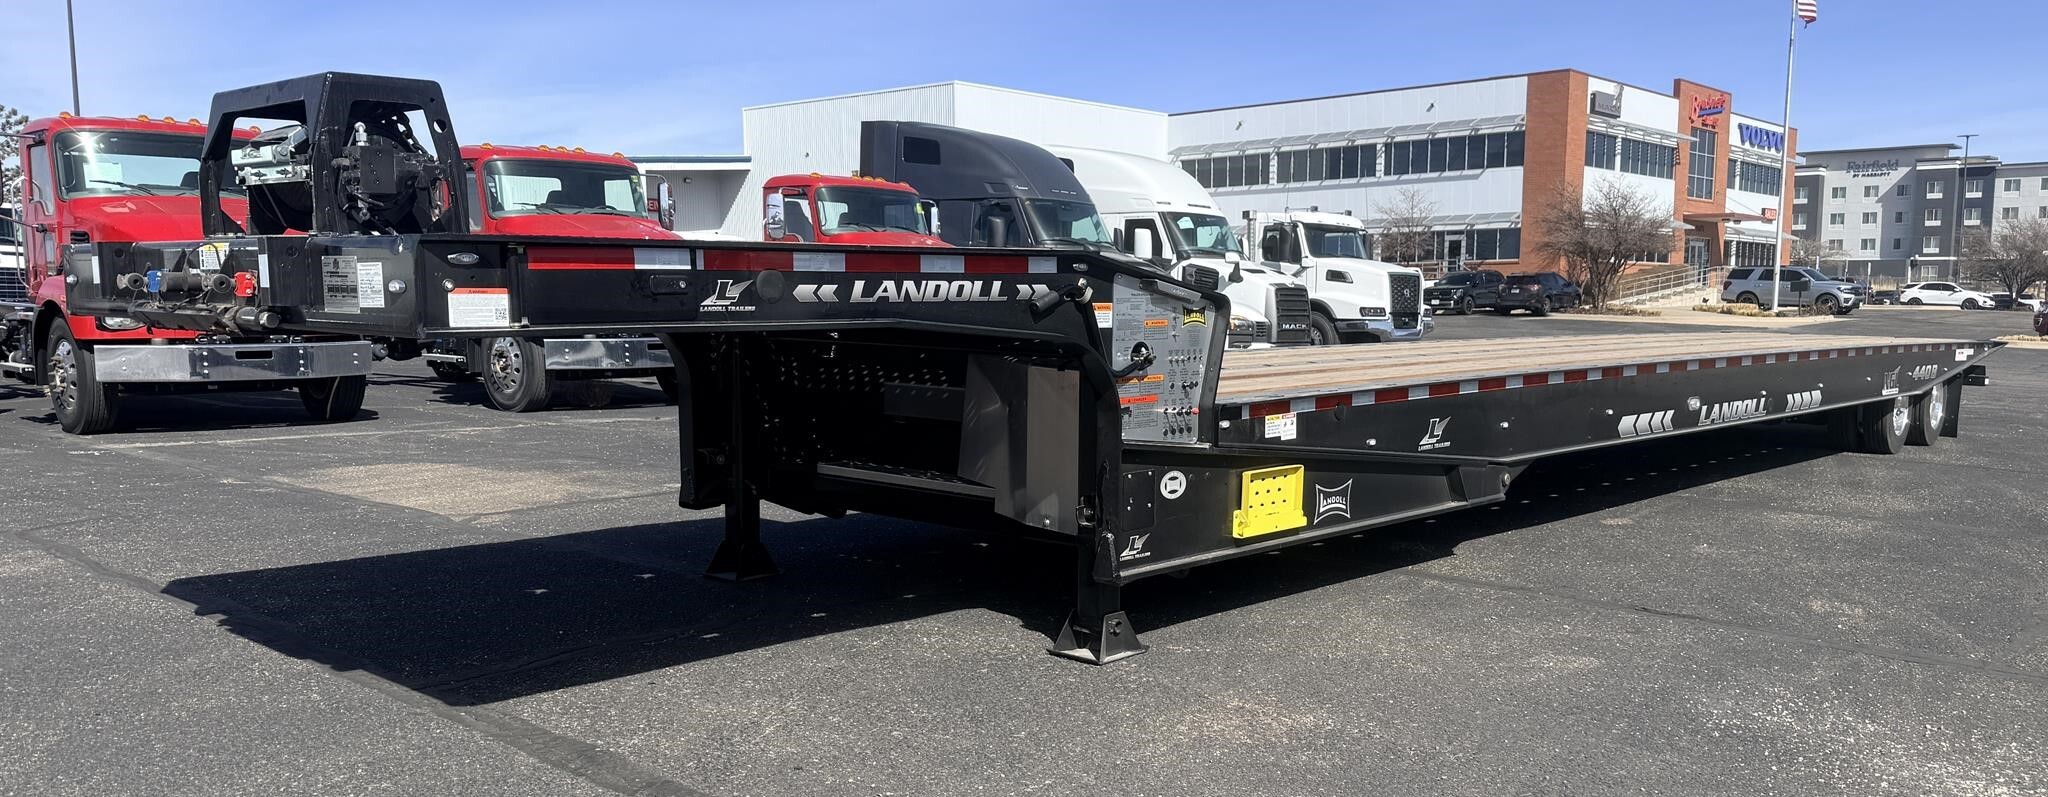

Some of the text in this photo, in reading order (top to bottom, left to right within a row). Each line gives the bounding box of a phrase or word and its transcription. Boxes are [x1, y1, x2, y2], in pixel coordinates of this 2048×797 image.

[1738, 122, 1784, 154] VOLVO
[1847, 160, 1899, 172] Fairfield
[850, 280, 1008, 303] LANDOLL
[1698, 397, 1767, 427] LANDOLL
[1320, 493, 1347, 513] LANDOLL
